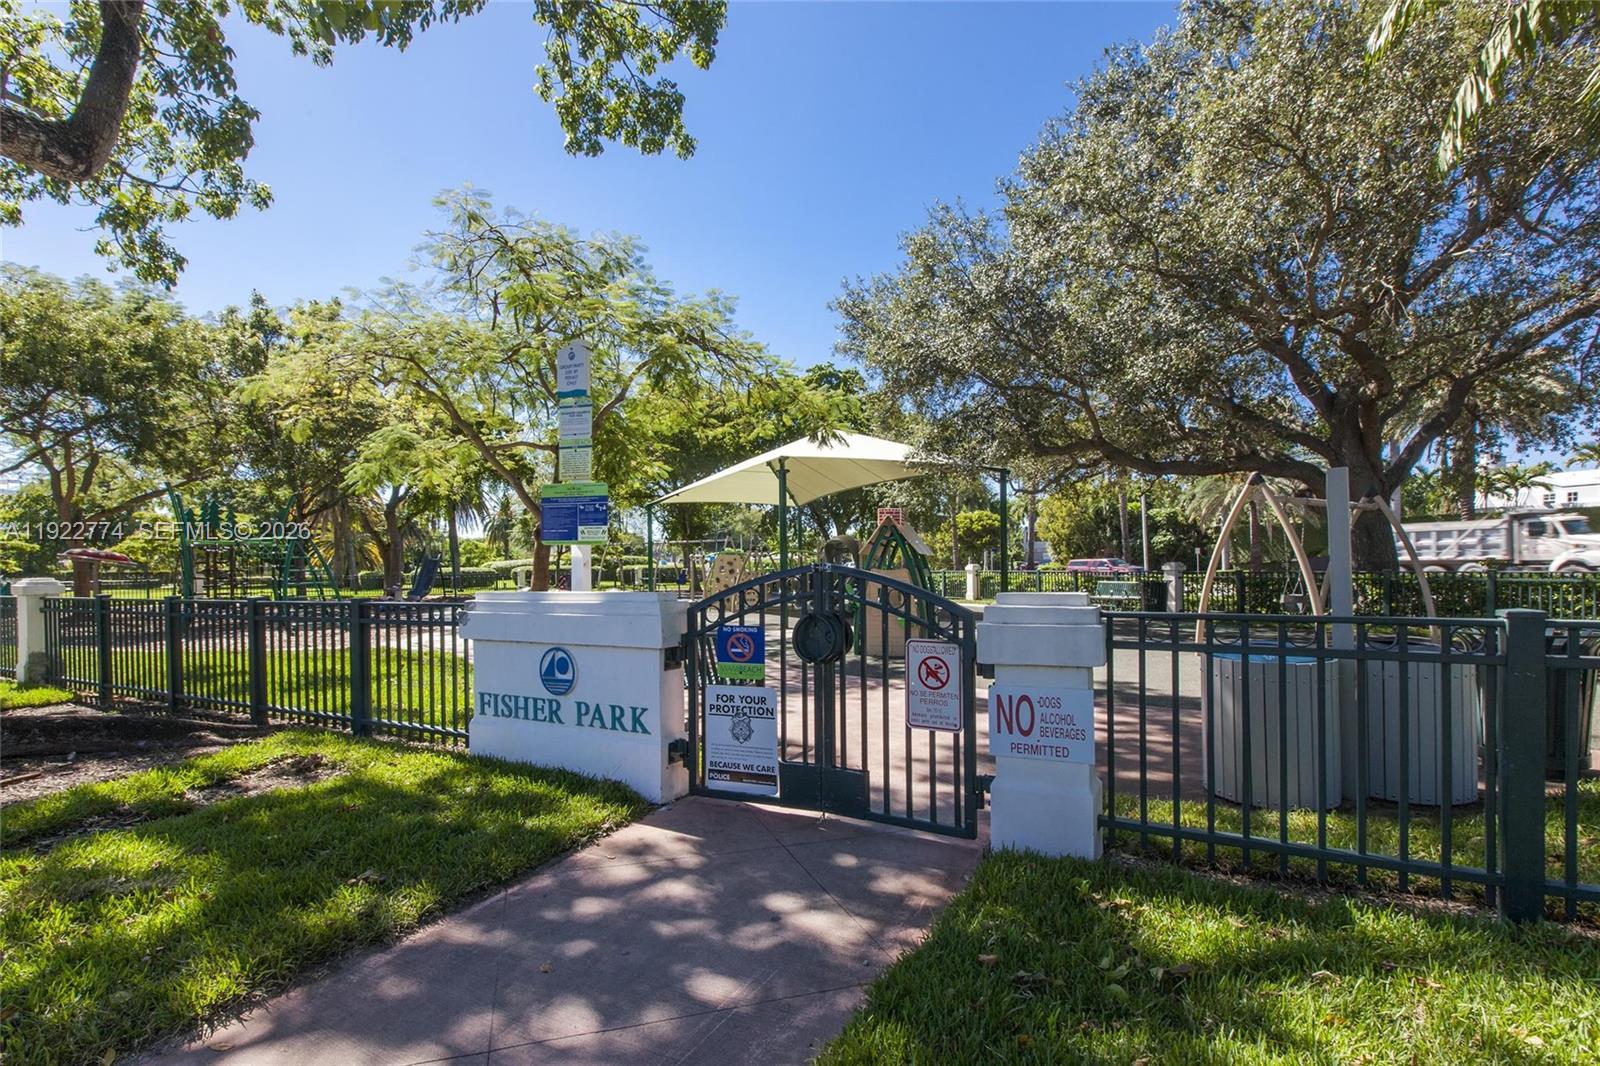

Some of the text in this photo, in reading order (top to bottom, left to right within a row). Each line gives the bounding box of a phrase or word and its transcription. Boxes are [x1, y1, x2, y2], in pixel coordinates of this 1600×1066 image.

[716, 694, 766, 706] FOR YOUR
[920, 698, 948, 706] PERROS
[928, 691, 958, 700] PERMITEN
[478, 692, 652, 735] FISHER PARK
[709, 704, 774, 717] PROTECTION
[996, 694, 1035, 737] NO
[1040, 713, 1077, 726] ALCOHOL
[1040, 726, 1086, 741] BEVERAGES
[1010, 742, 1070, 758] PERMITTED
[709, 760, 741, 770] BECAUSE
[756, 765, 776, 774] CARE
[710, 772, 730, 780] POLICE
